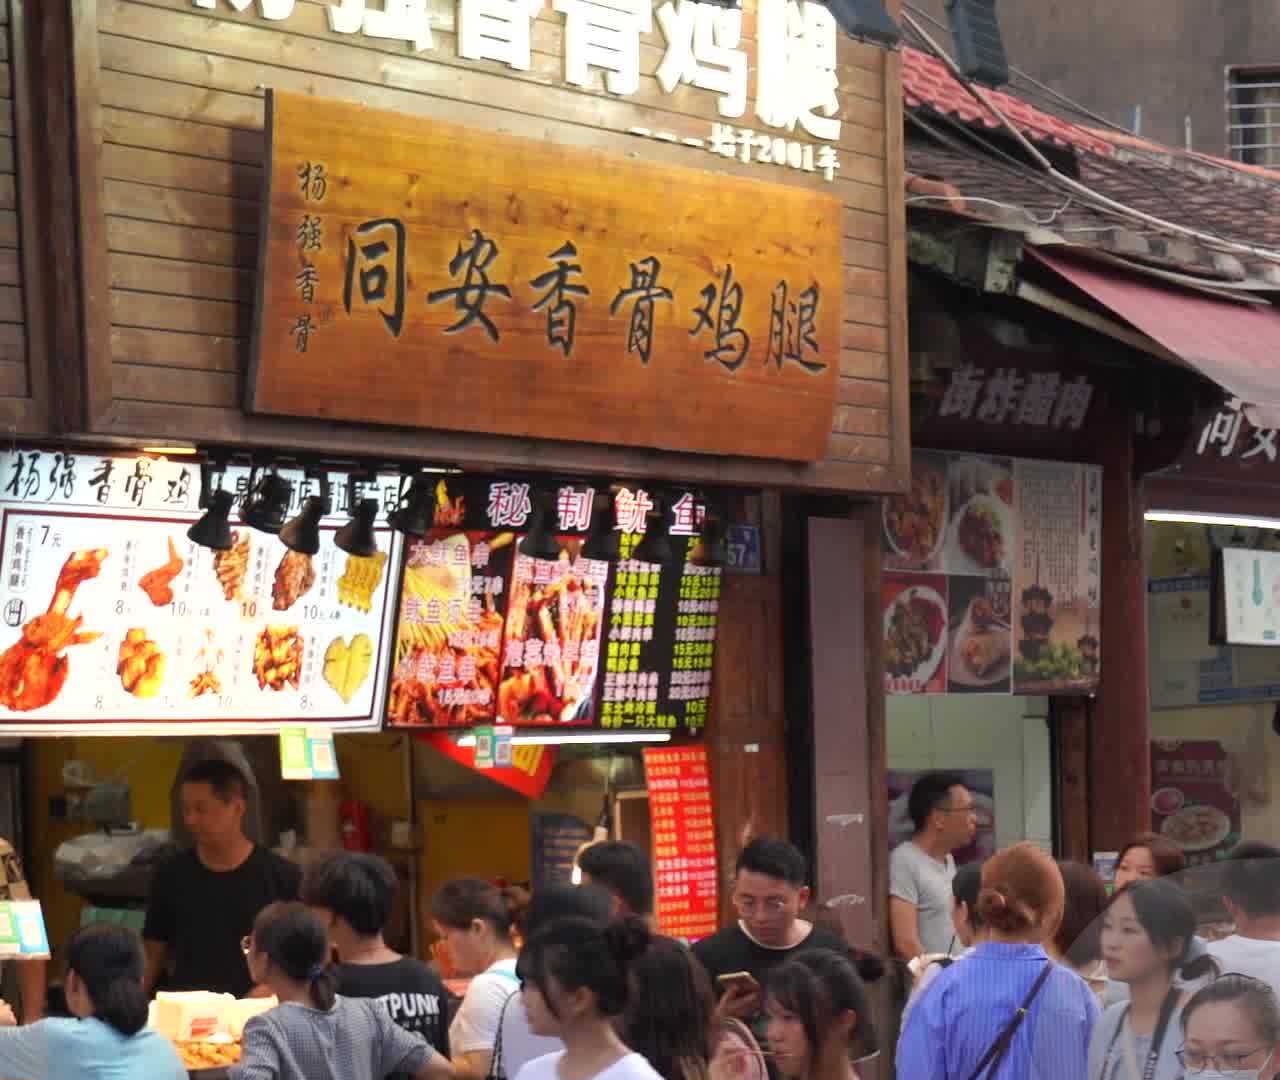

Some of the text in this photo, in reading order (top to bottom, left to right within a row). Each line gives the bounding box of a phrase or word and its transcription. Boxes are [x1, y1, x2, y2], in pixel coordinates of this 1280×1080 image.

[290, 160, 328, 354] 杨强香骨
[342, 217, 828, 374] 同安香骨鸡腿
[488, 482, 707, 536] 秘制鱿鱼
